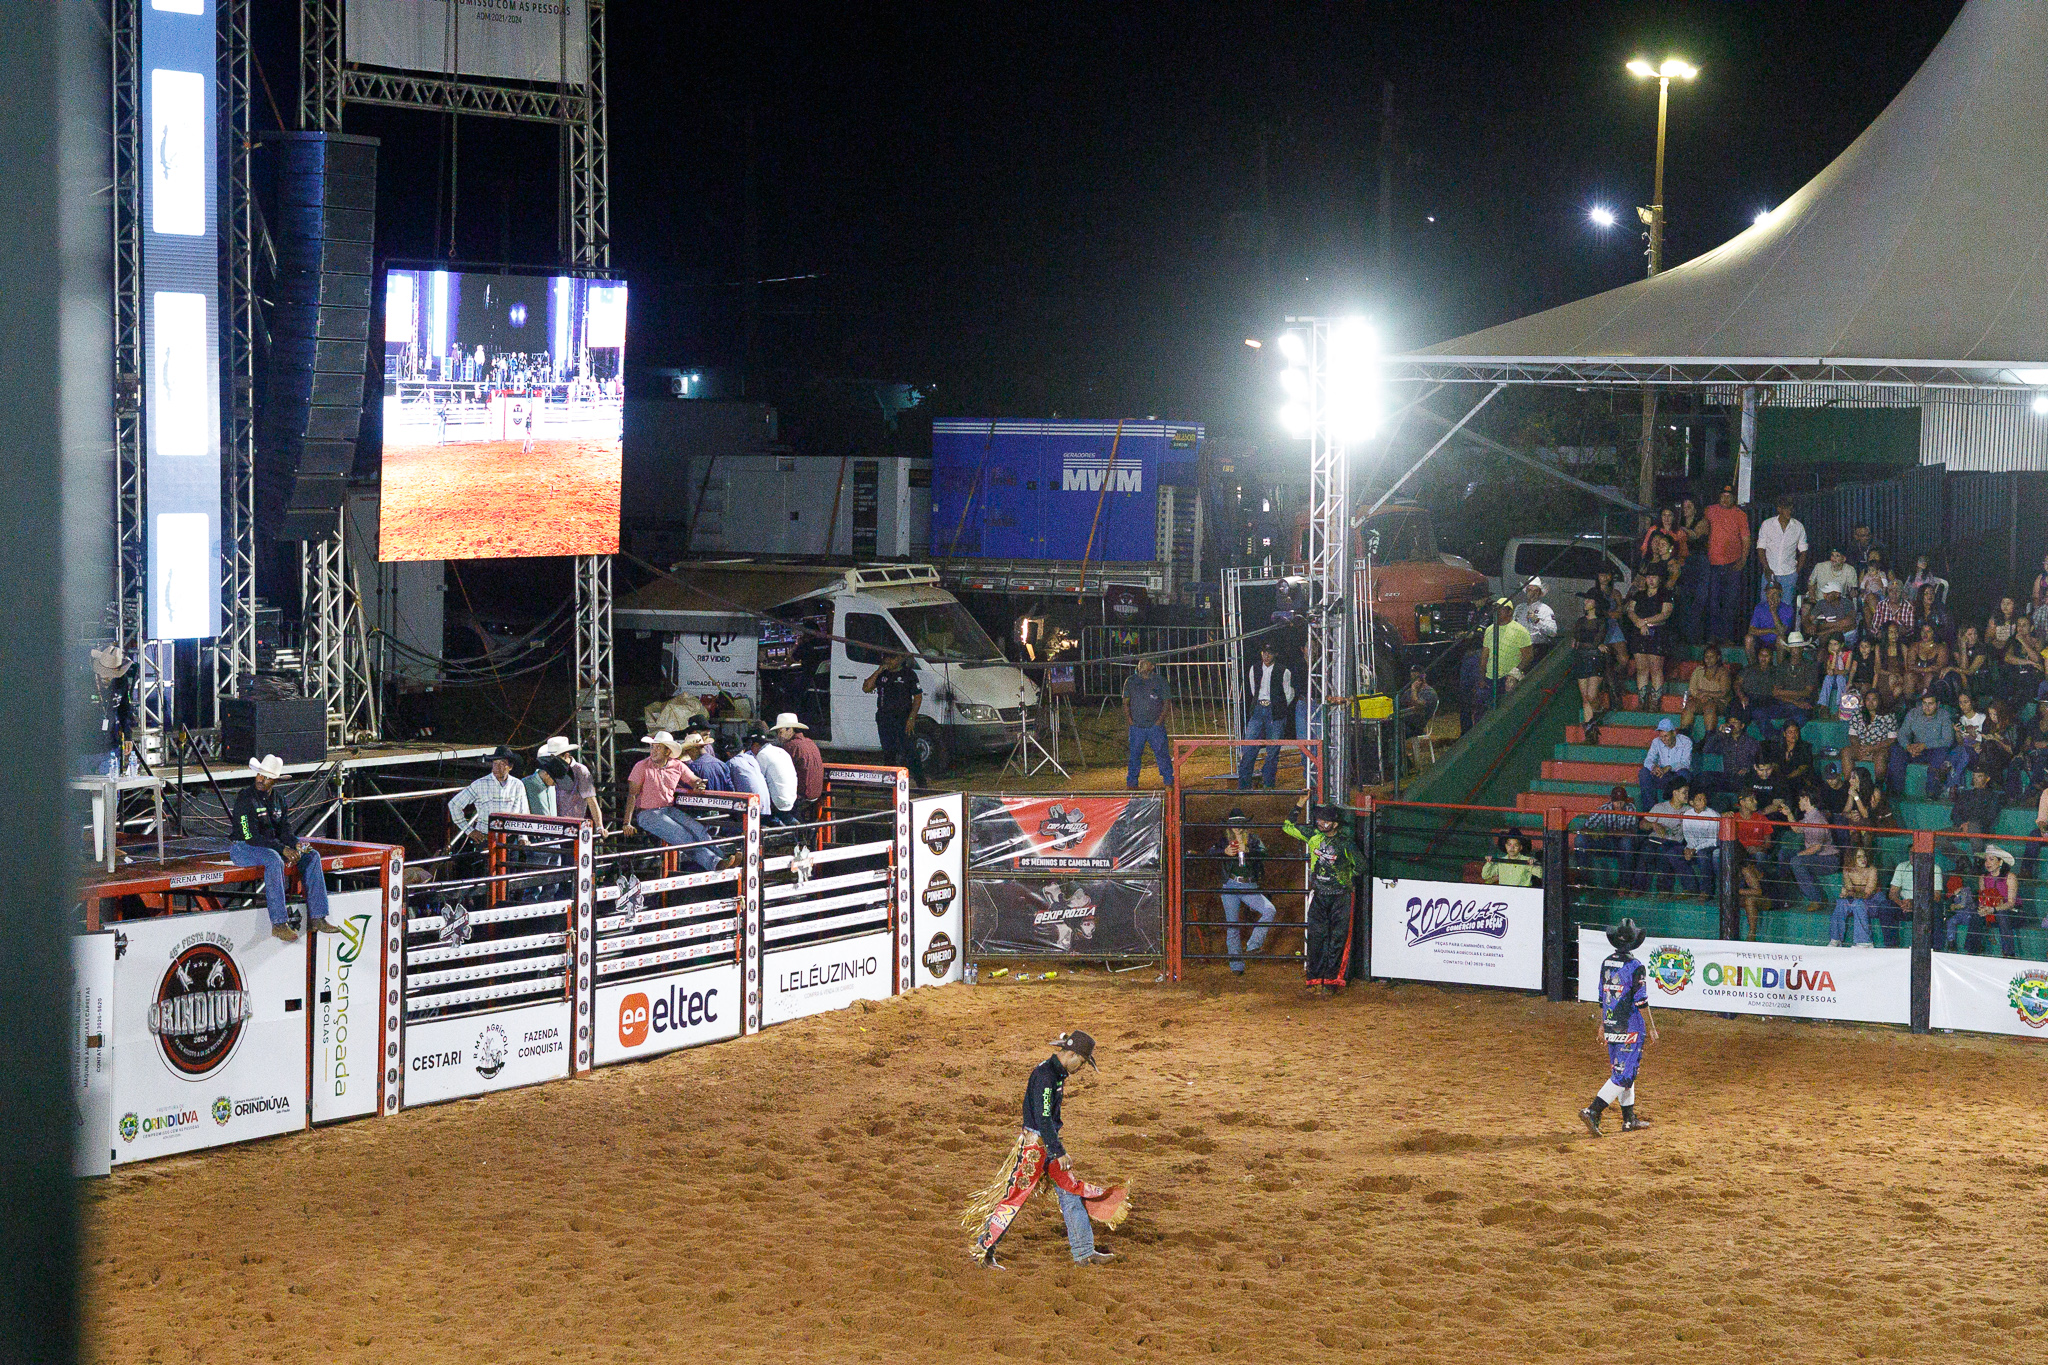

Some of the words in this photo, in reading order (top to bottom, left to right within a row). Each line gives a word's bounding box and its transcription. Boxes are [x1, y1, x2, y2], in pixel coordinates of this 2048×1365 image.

[496, 0, 516, 10] COM
[519, 2, 530, 12] AS
[1063, 469, 1142, 492] MWM
[504, 820, 534, 829] ARENA
[170, 875, 198, 884] ARENA
[200, 872, 224, 880] PRIME
[1405, 896, 1508, 941] RODOCAR
[1476, 920, 1484, 929] DE
[1736, 952, 1790, 961] PREFEITURA
[1792, 954, 1803, 962] DE
[780, 956, 877, 992] LELÉUZINHO
[1702, 962, 1836, 992] ORINDIÚVA
[1702, 988, 1764, 999] COMPROMISSO
[1788, 993, 1798, 1001] AS
[1800, 994, 1837, 1004] PESSOAS
[1762, 1001, 1791, 1009] 2021/2024
[322, 976, 330, 1044] AGCOLAS
[652, 984, 718, 1034] eltec
[486, 1023, 508, 1056] AGRÍCOLA
[524, 1028, 559, 1043] FAZENDA
[518, 1041, 564, 1058] CONQUISTA
[412, 1050, 462, 1072] CESTARI
[234, 1096, 290, 1116] ORINDIÚVA
[142, 1108, 198, 1132] ORINDIÚVA
